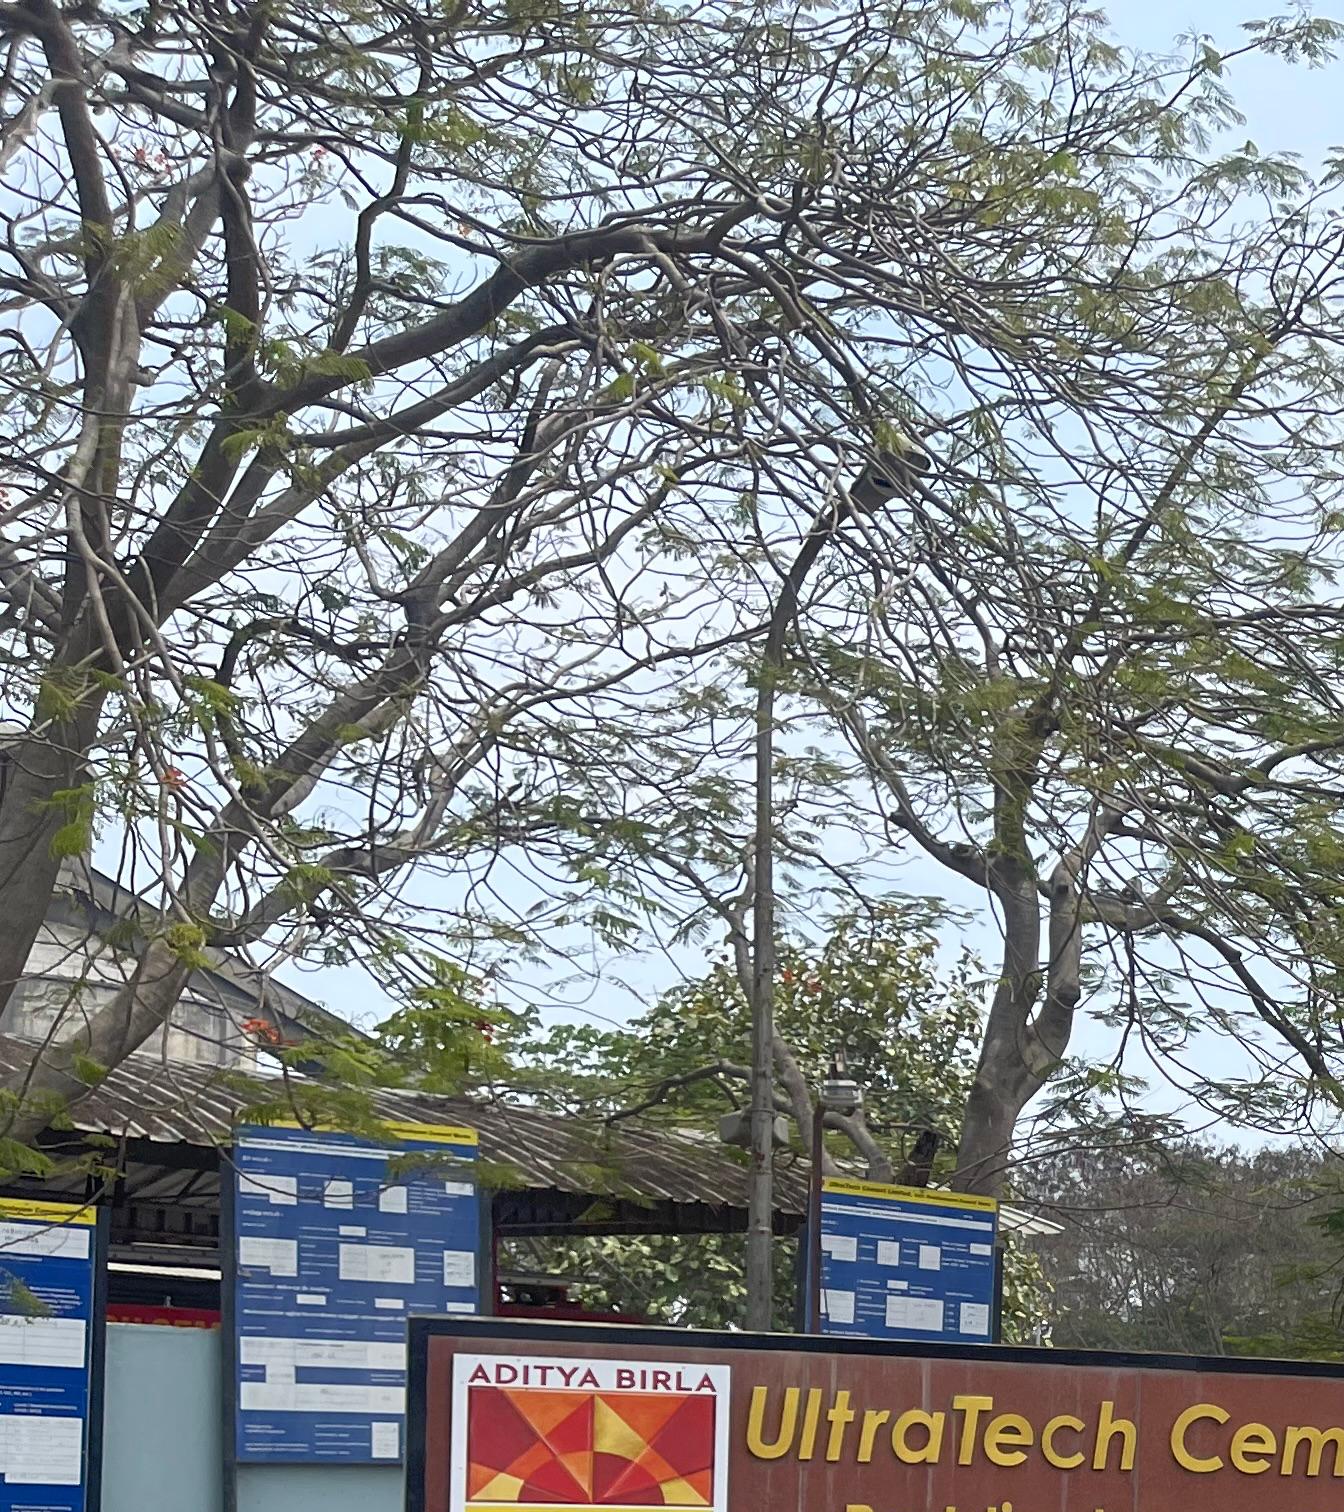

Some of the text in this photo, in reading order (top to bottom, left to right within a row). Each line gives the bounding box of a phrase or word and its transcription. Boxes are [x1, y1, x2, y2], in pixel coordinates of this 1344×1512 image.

[467, 1363, 718, 1394] ADITYA BIRLA
[745, 1385, 1138, 1471] UltraTech
